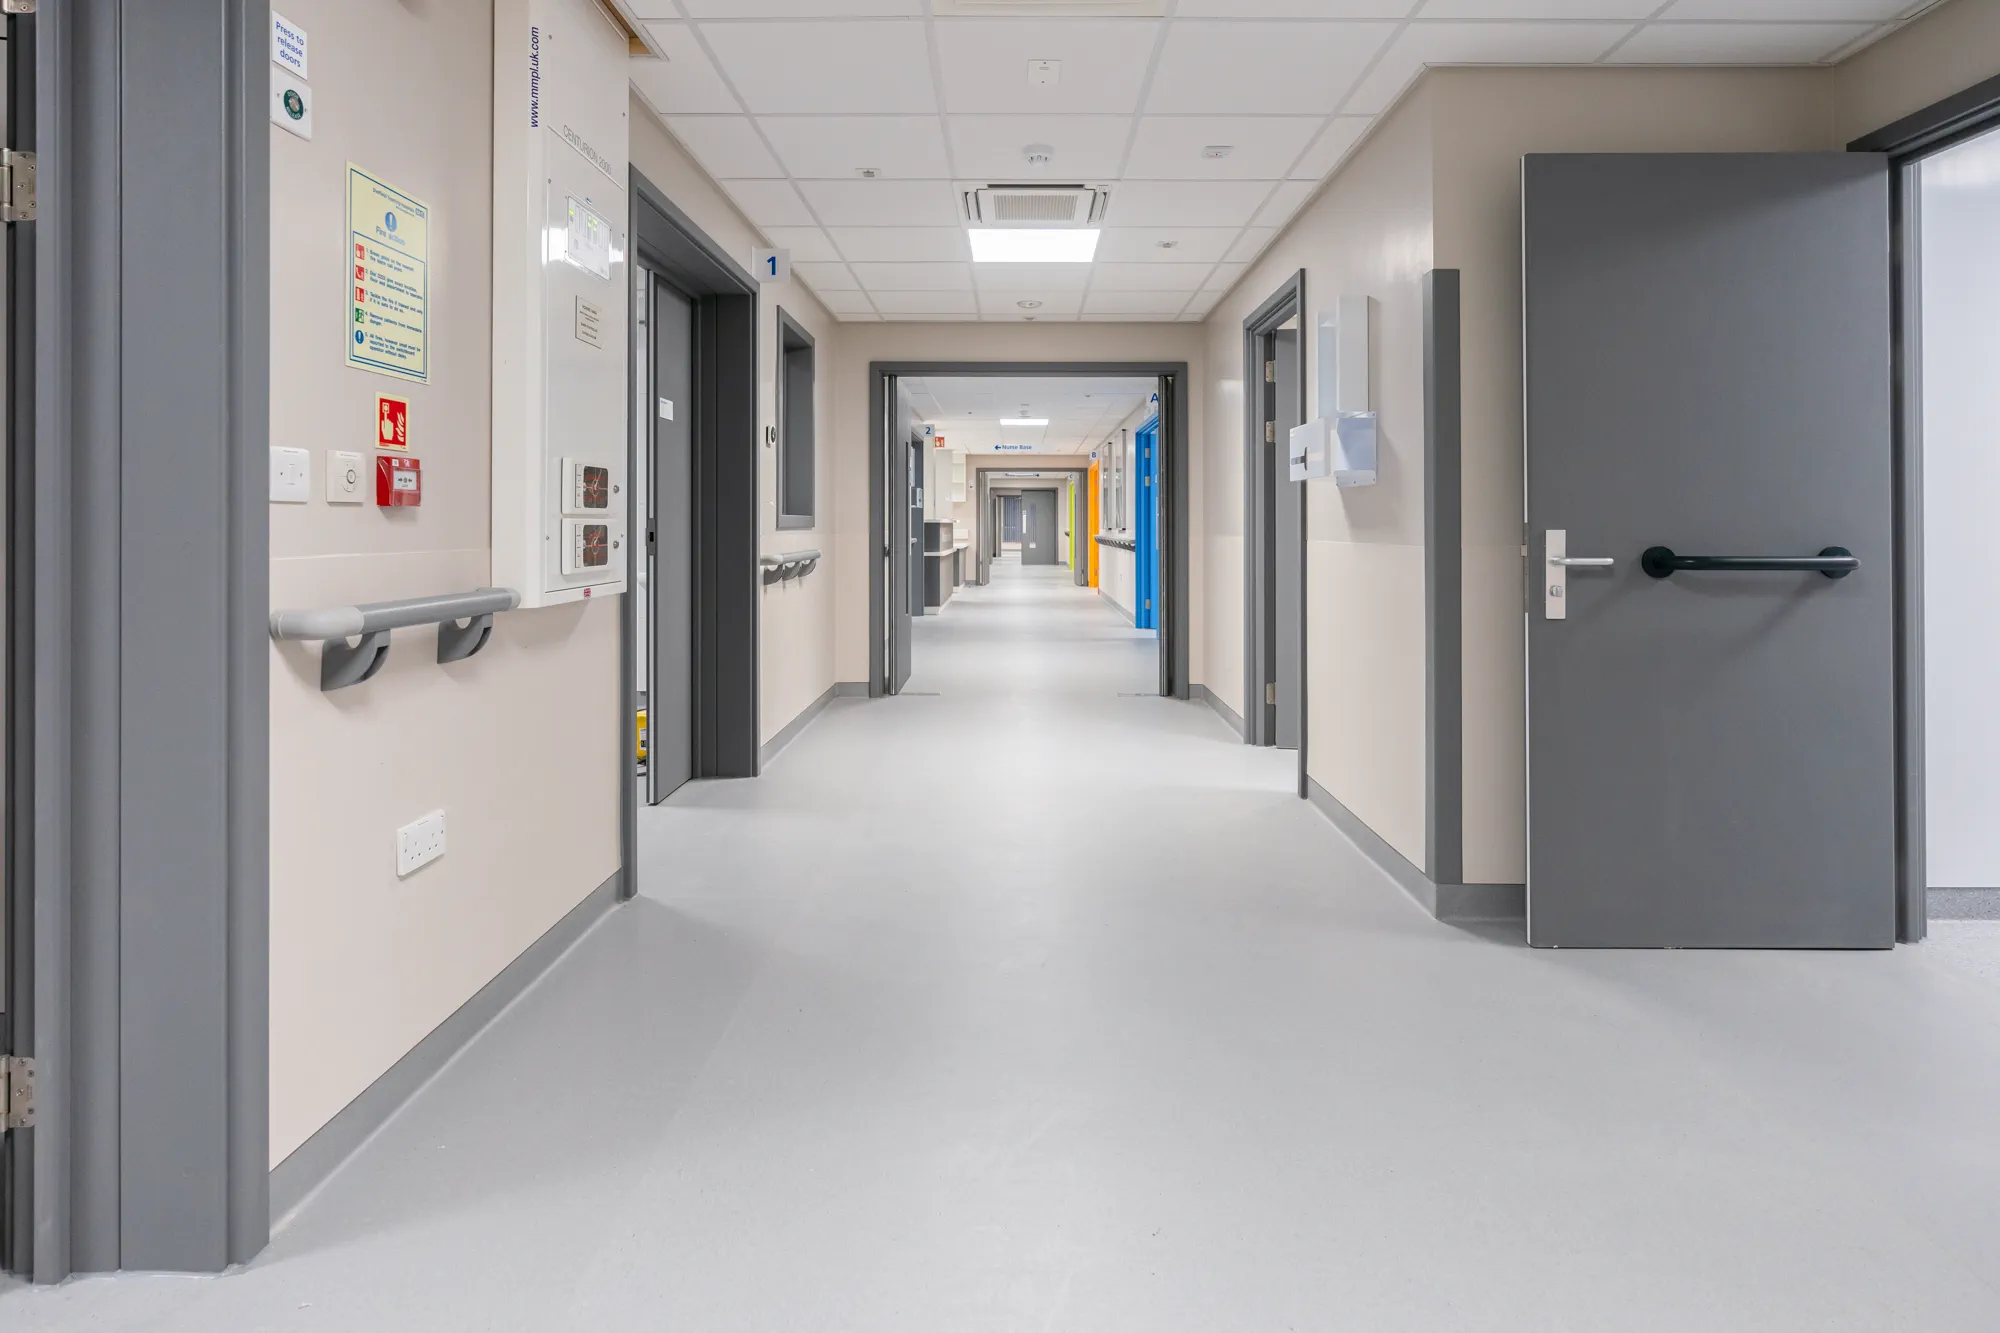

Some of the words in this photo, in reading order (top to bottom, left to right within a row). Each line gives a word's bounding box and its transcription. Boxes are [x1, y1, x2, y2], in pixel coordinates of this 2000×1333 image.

[276, 21, 295, 40] Press
[296, 35, 304, 46] to
[277, 35, 303, 57] release
[280, 49, 300, 67] doors
[529, 26, 541, 128] www.mmpl.uk.com
[563, 124, 598, 164] CENTURION
[598, 156, 612, 175] 2000
[376, 226, 386, 237] Fire
[767, 256, 776, 275] 1
[1150, 392, 1159, 402] A
[926, 426, 931, 434] 2
